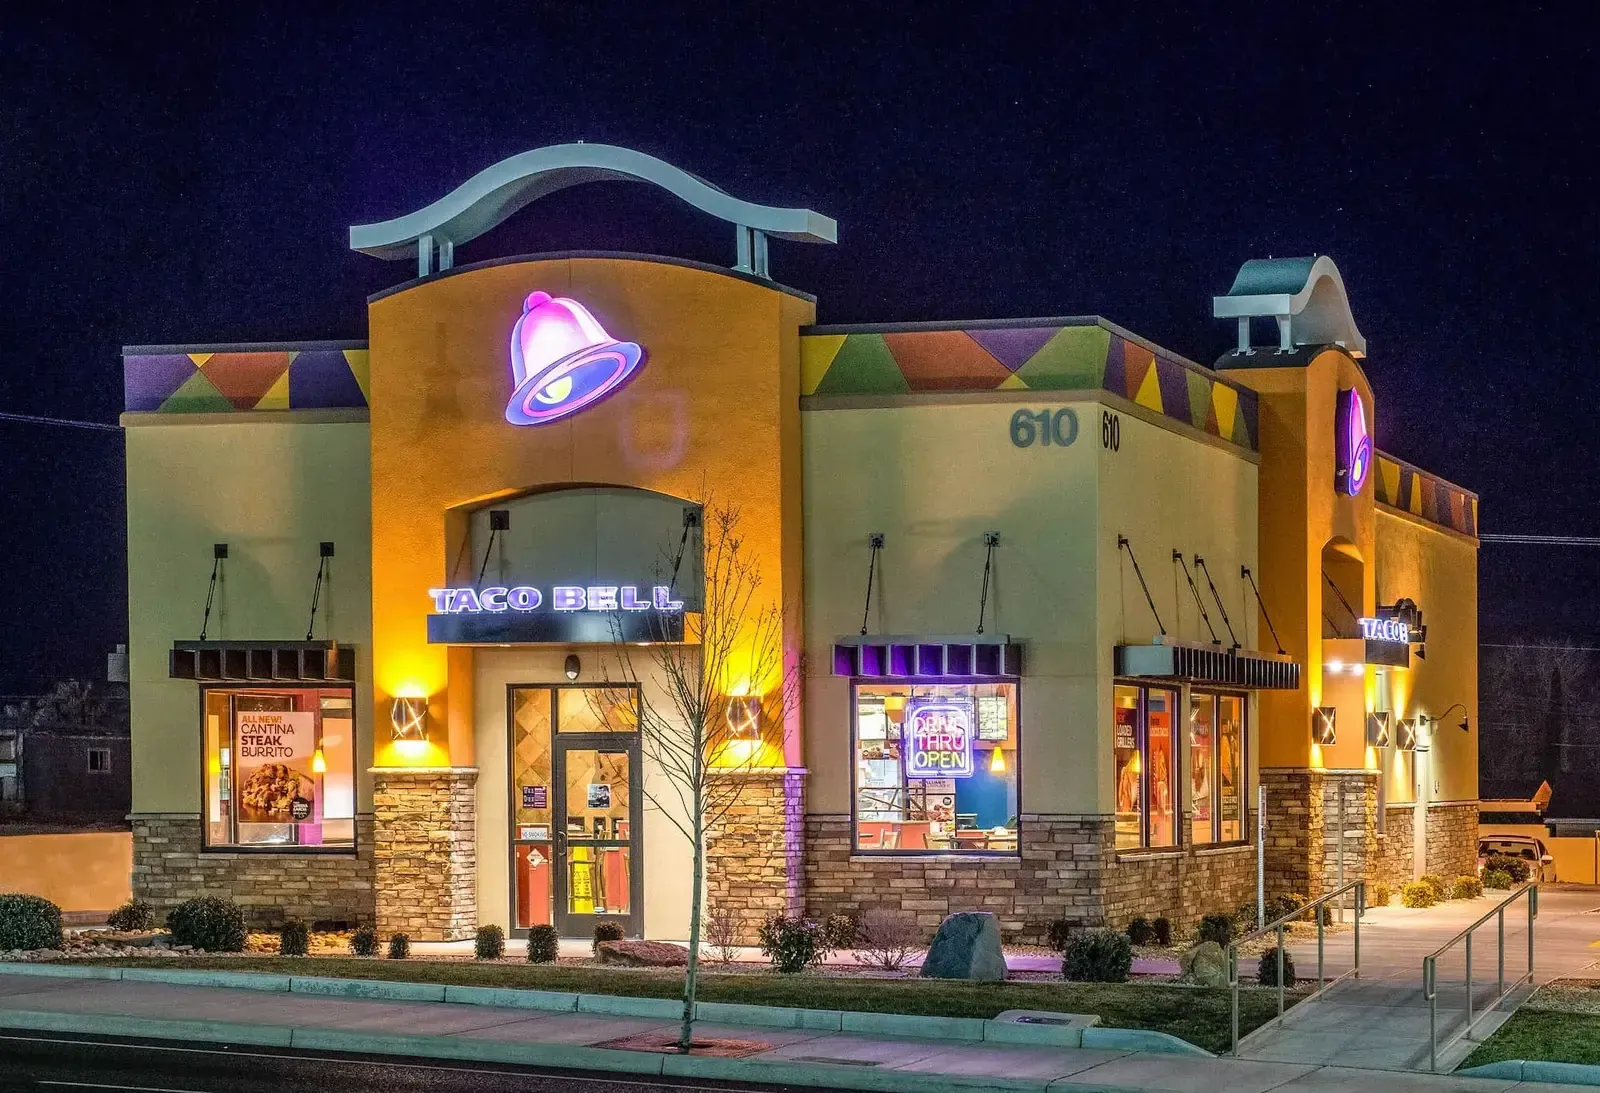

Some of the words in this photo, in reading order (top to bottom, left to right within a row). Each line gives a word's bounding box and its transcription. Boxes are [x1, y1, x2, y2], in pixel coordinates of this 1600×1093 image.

[1010, 408, 1078, 448] 610
[1102, 410, 1120, 452] 610
[428, 586, 542, 612] TACO
[553, 586, 684, 612] BELL
[242, 715, 258, 724] ALL
[260, 715, 282, 724] NEW!
[914, 716, 966, 733] DRIVE
[241, 724, 295, 735] CANTINA
[241, 736, 282, 746] STEAK
[915, 733, 966, 751] THRU
[241, 747, 293, 758] BURRITO
[915, 751, 965, 768] OPEN
